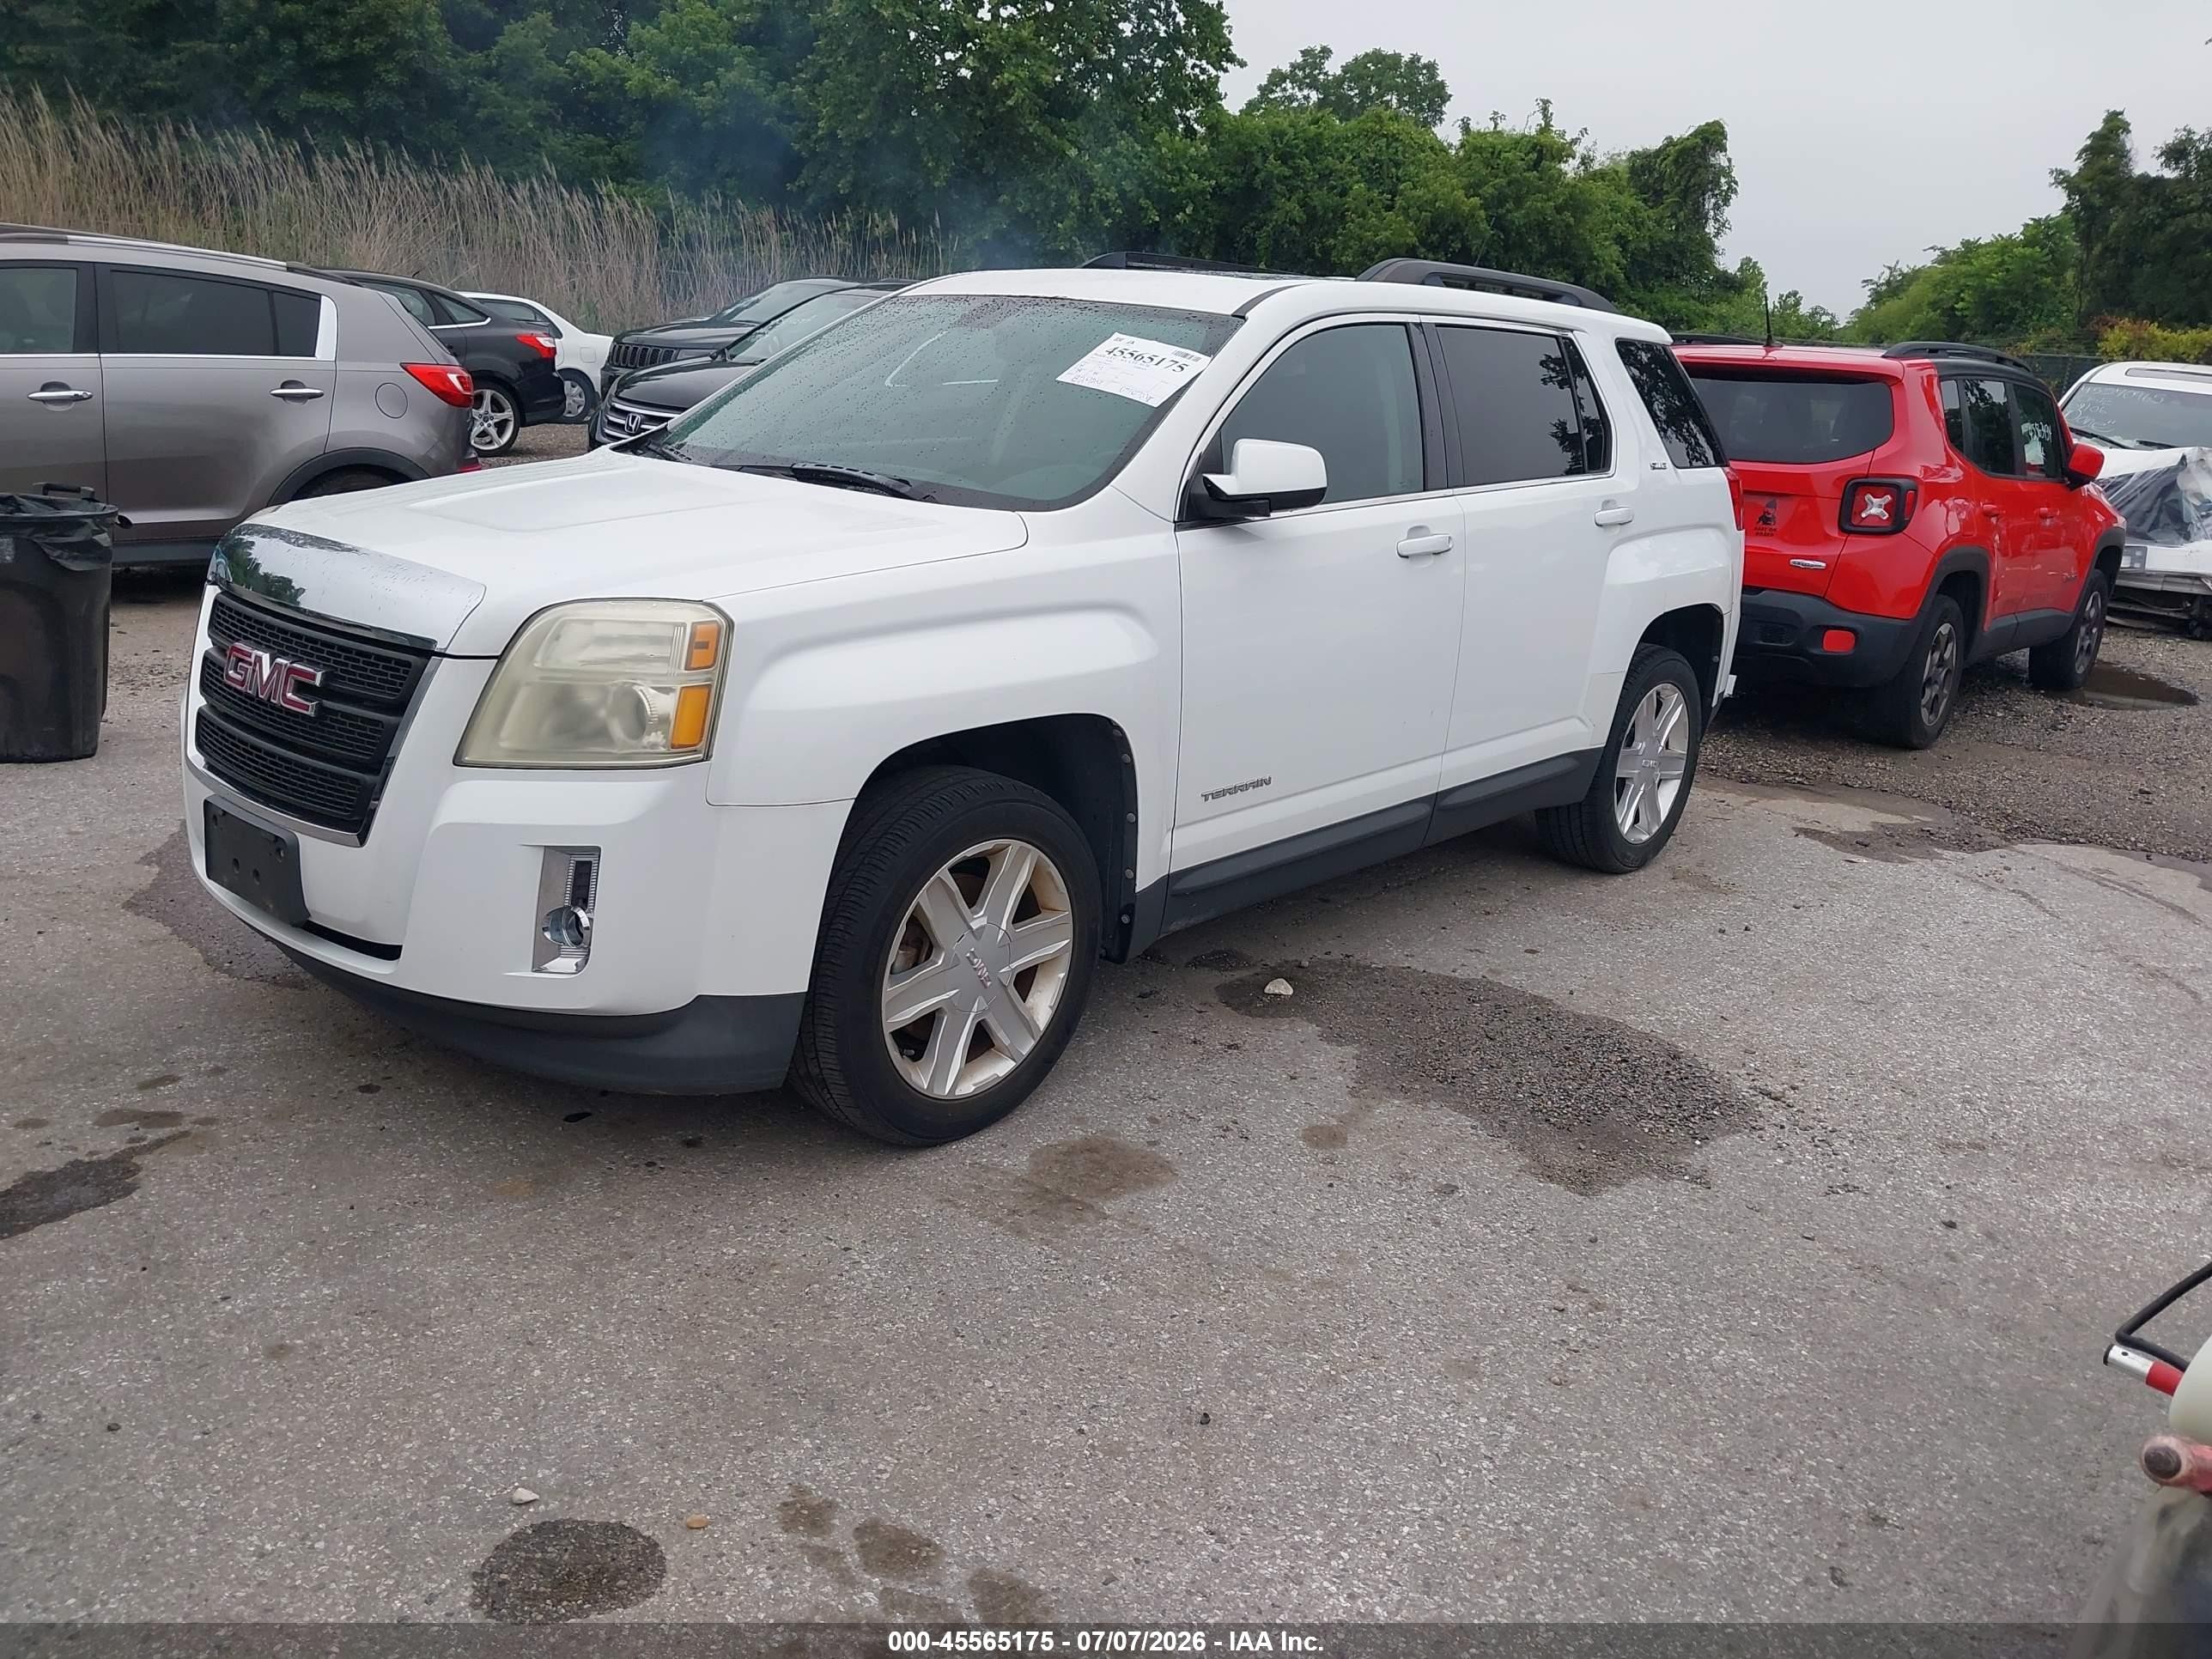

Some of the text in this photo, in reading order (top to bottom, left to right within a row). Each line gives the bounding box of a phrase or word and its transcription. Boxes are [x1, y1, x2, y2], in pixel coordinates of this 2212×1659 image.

[1105, 346, 1189, 373] 45565175
[224, 642, 324, 717] GMC
[1200, 775, 1272, 802] TERRAIN
